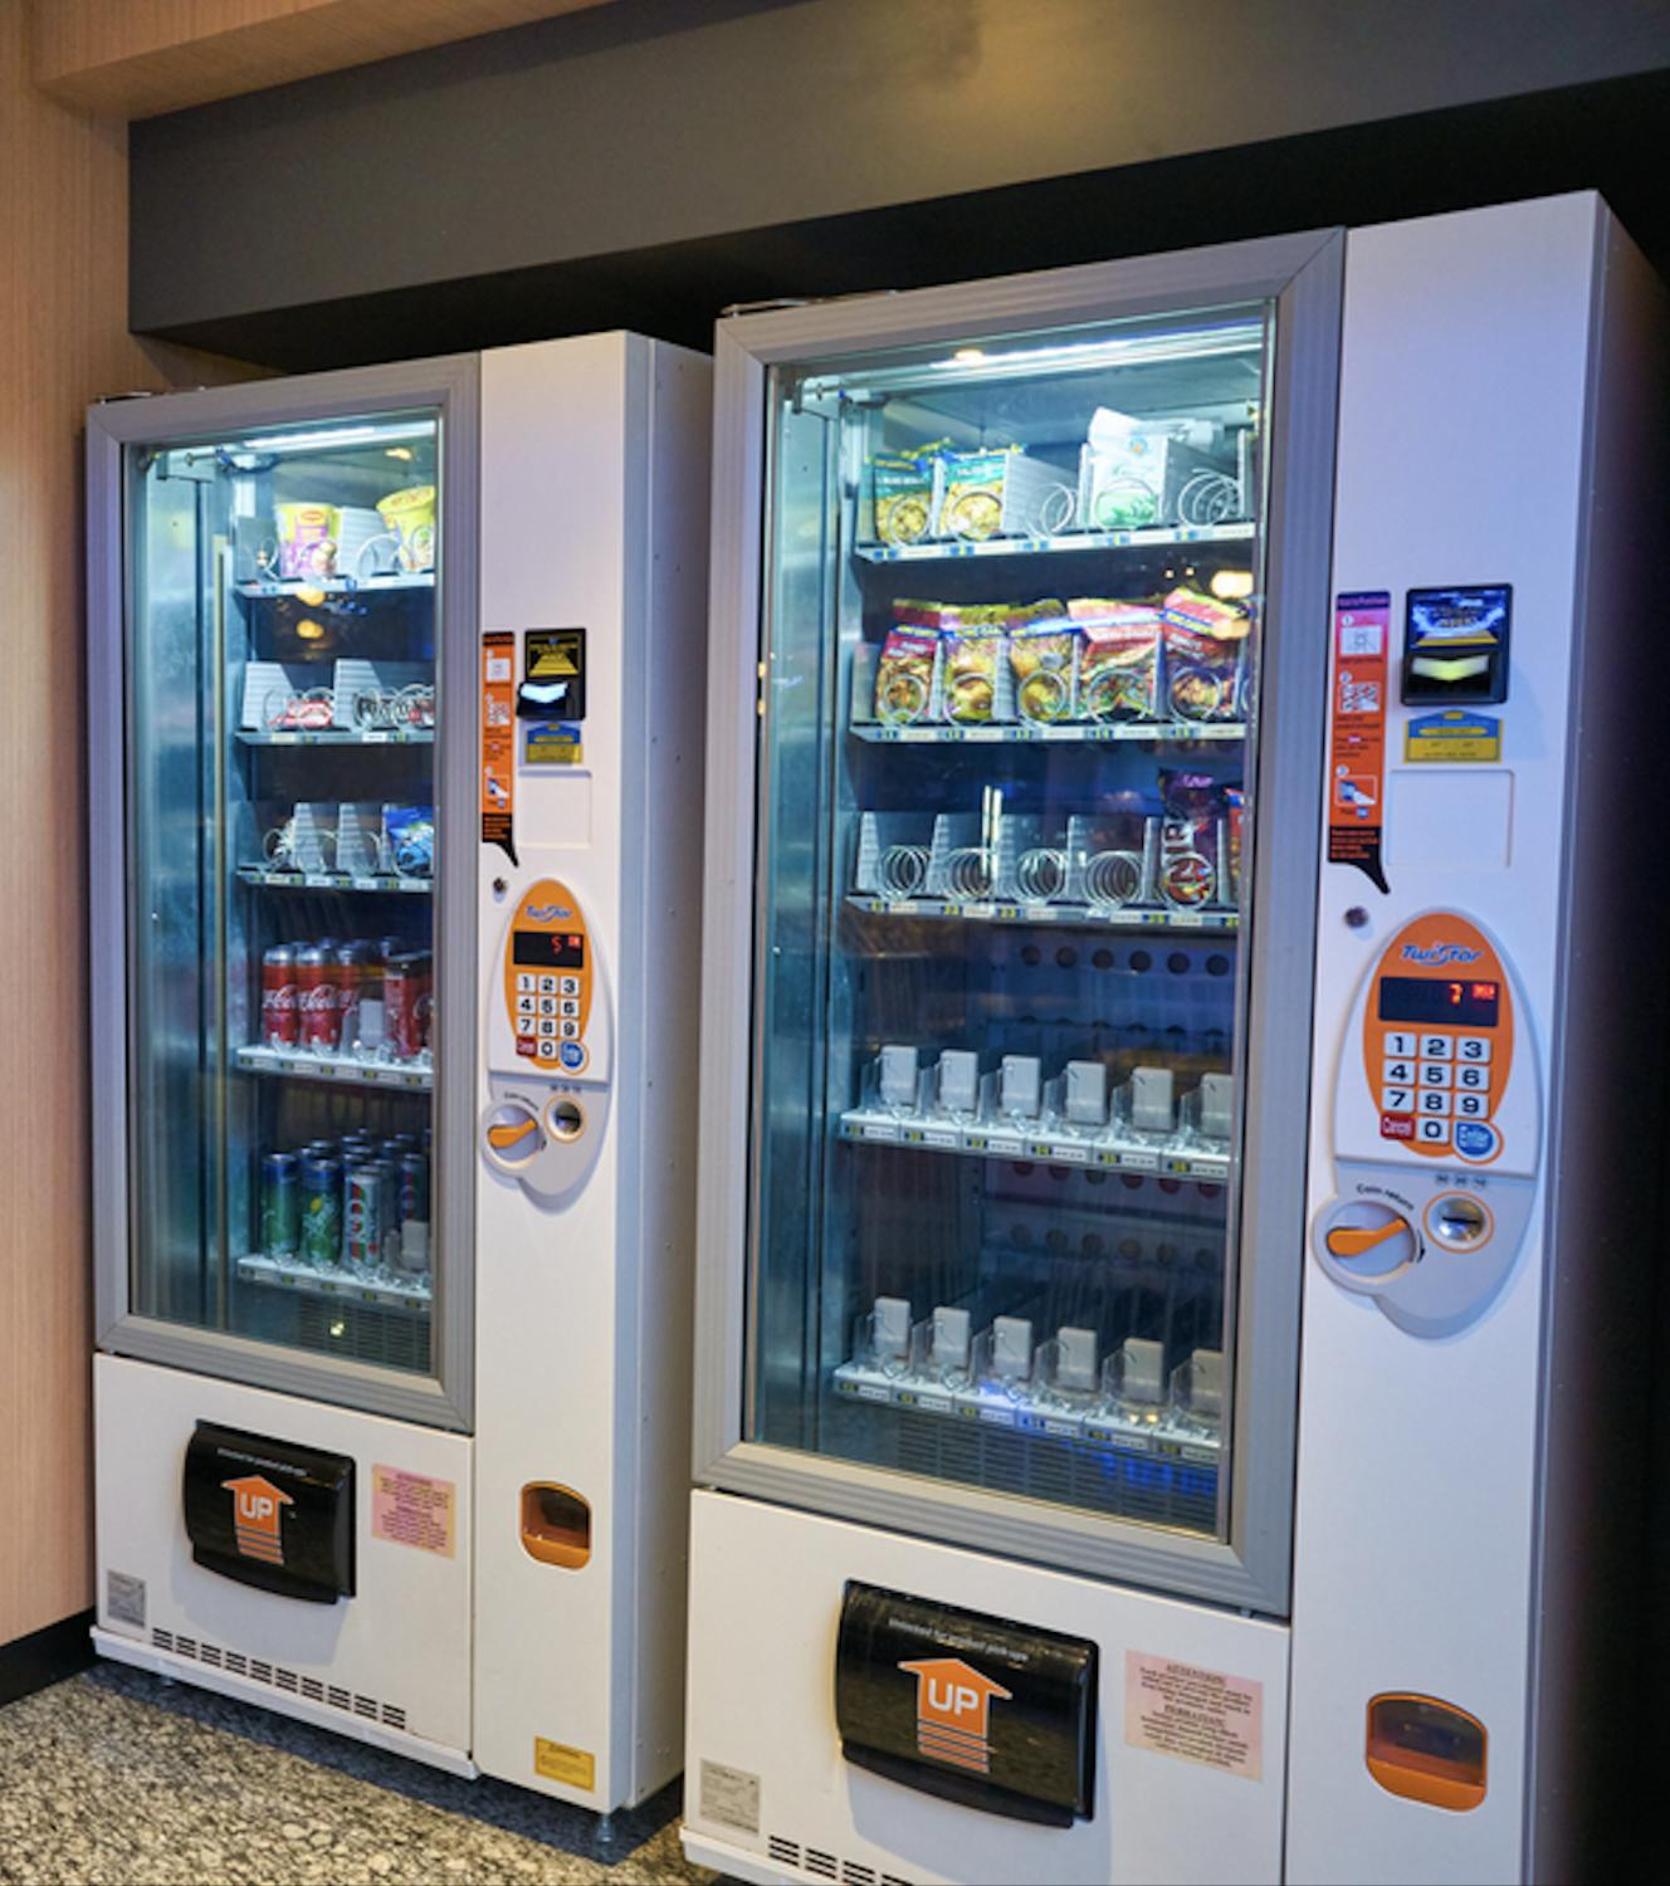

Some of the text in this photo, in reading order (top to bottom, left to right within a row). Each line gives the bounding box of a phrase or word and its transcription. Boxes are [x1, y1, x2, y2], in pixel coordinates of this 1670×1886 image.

[523, 976, 575, 993] 1 2 3
[521, 998, 575, 1014] 4 5 6
[521, 1019, 575, 1036] 7 8 9
[541, 1041, 553, 1056] 0
[1394, 1036, 1482, 1058] 1 2 3
[1390, 1064, 1480, 1086] 4 5 6
[1389, 1090, 1480, 1114] 7 8 9
[1424, 1121, 1442, 1138] 0
[239, 1491, 275, 1521] UP
[928, 1678, 979, 1715] UP
